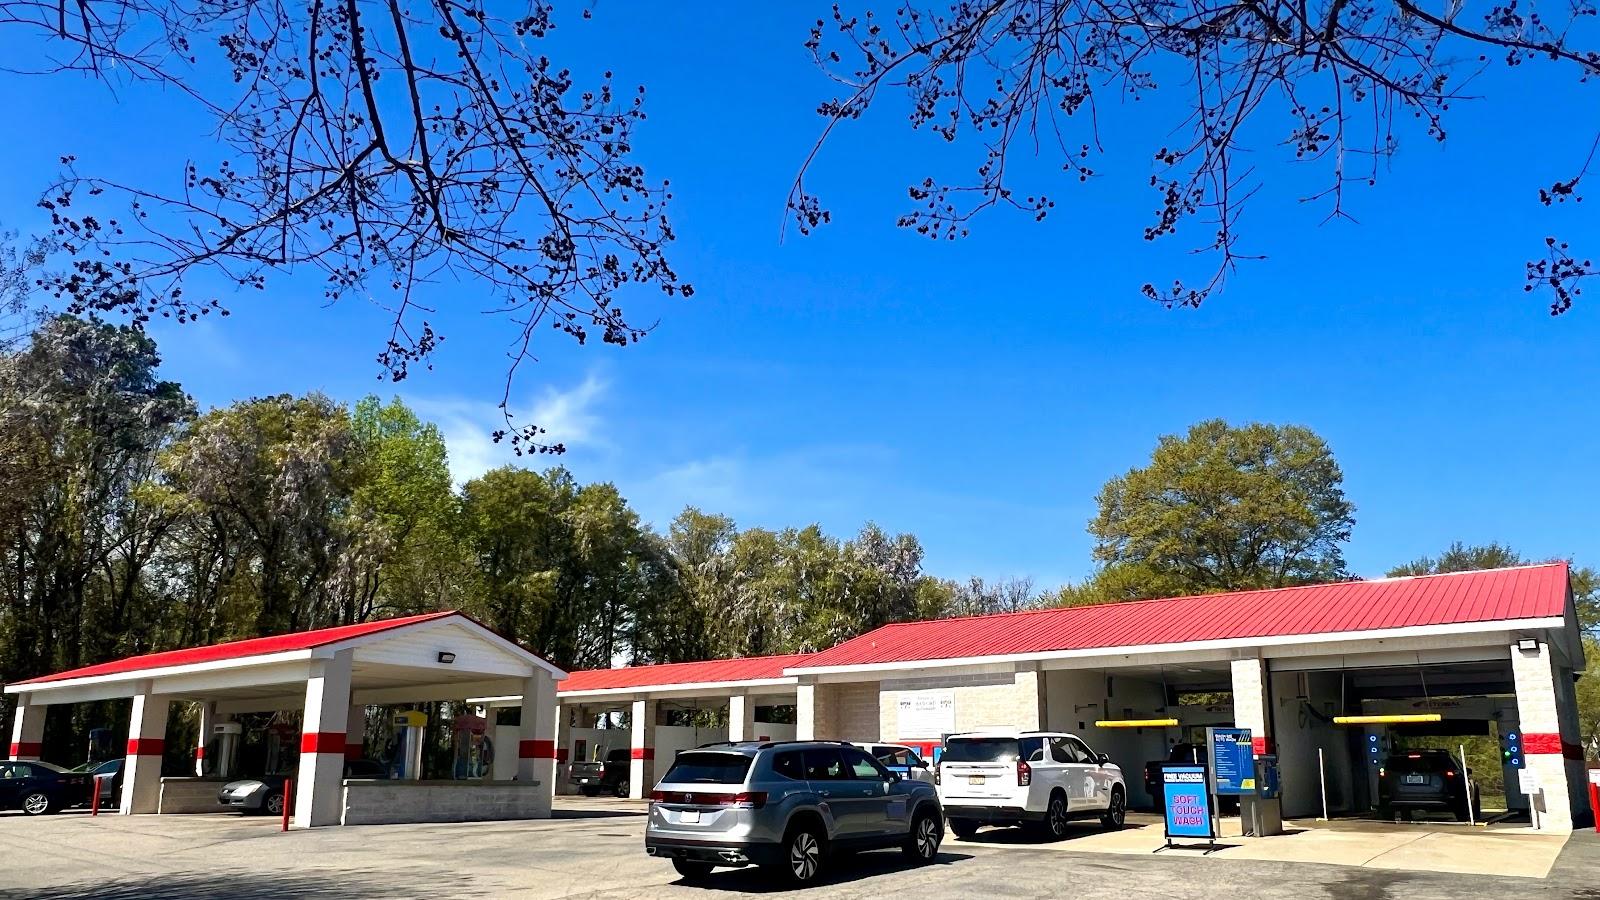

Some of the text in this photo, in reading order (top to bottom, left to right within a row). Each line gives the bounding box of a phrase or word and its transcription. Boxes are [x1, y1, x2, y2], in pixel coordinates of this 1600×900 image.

[1173, 795, 1197, 804] SOFT
[1170, 805, 1204, 815] TOUCH
[1173, 816, 1203, 825] WASH
